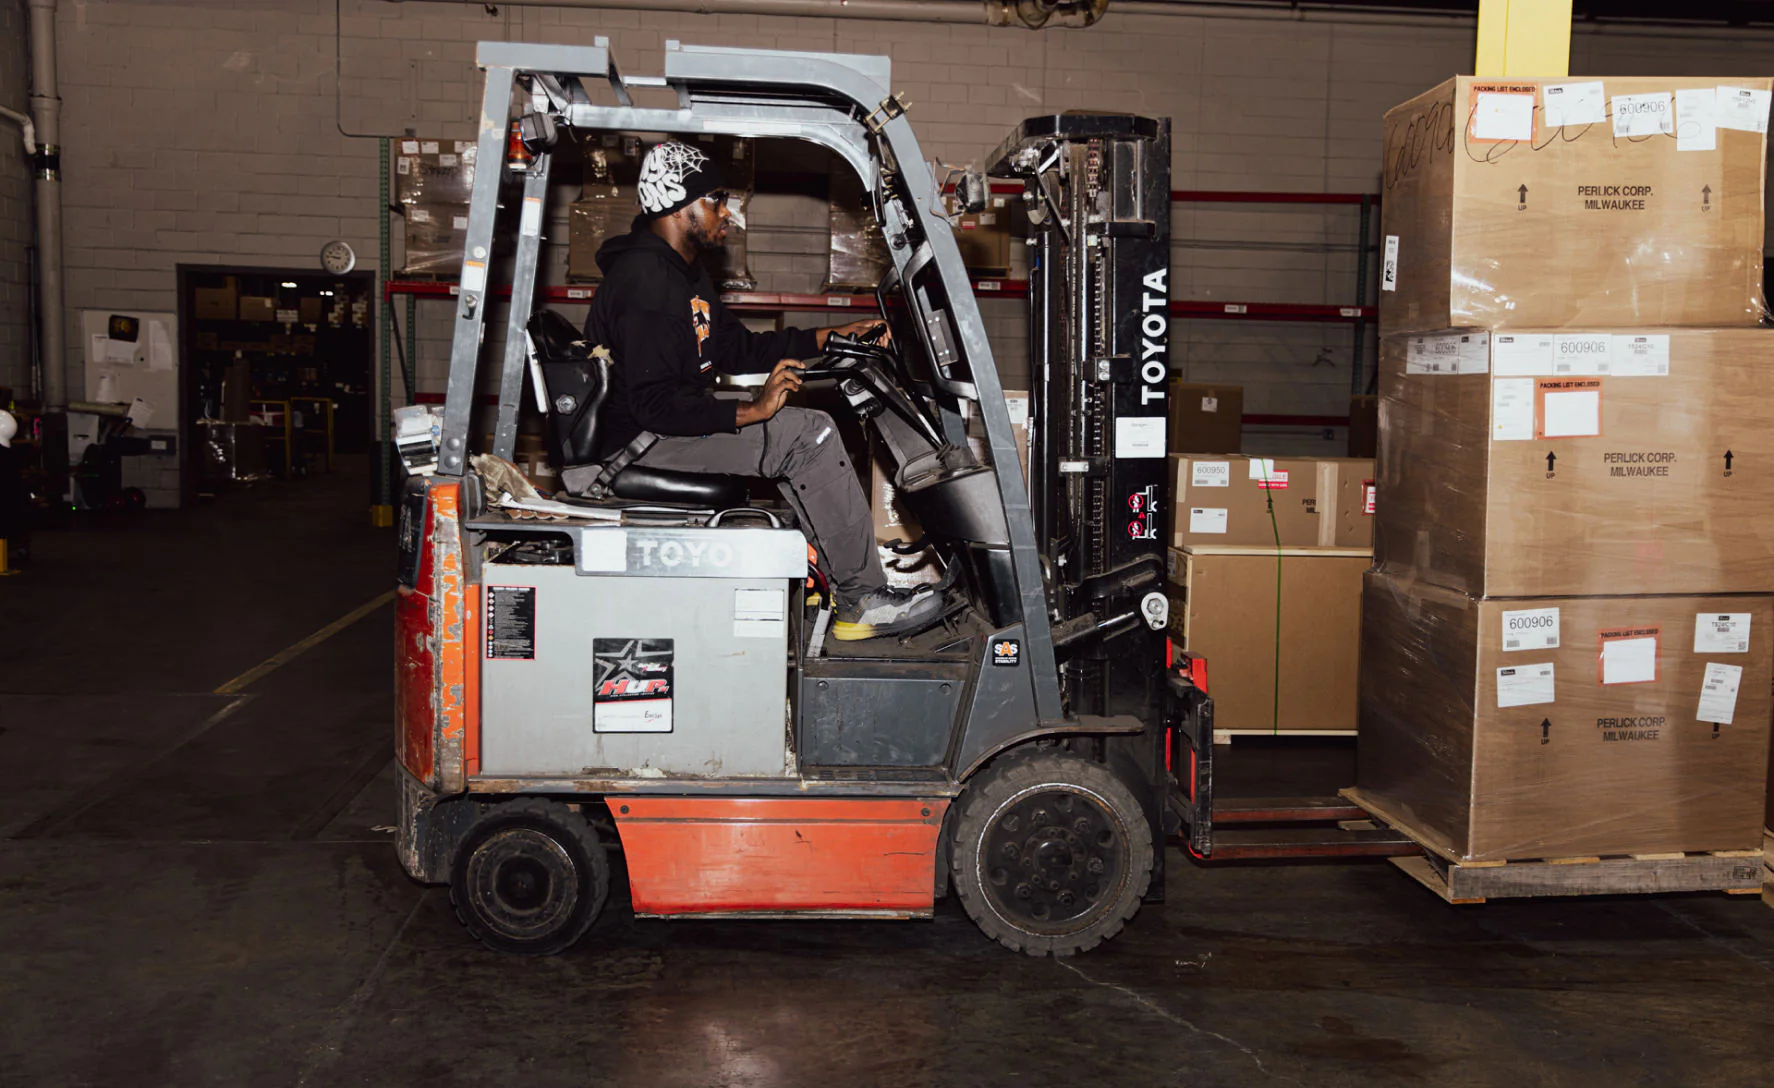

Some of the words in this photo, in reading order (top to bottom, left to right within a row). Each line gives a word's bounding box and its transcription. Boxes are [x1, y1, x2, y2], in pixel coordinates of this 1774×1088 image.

[1620, 101, 1665, 115] 600906
[1578, 185, 1621, 197] PERLICK
[1622, 185, 1654, 197] CORP.
[1517, 204, 1528, 212] UP
[1584, 199, 1646, 211] MILWAUKEE
[1141, 268, 1167, 405] TOYOTA
[1560, 341, 1605, 354] 600906
[1603, 452, 1646, 464] PERLICK
[1646, 452, 1677, 463] CORP.
[1610, 466, 1669, 477] MILWAUKEE
[1509, 615, 1554, 630] 600906
[1600, 631, 1622, 639] PACKING
[994, 641, 1018, 656] SAS
[1597, 717, 1638, 728] PERLICK
[1638, 716, 1668, 728] CORP.
[1602, 730, 1660, 742] MILWAUKEE
